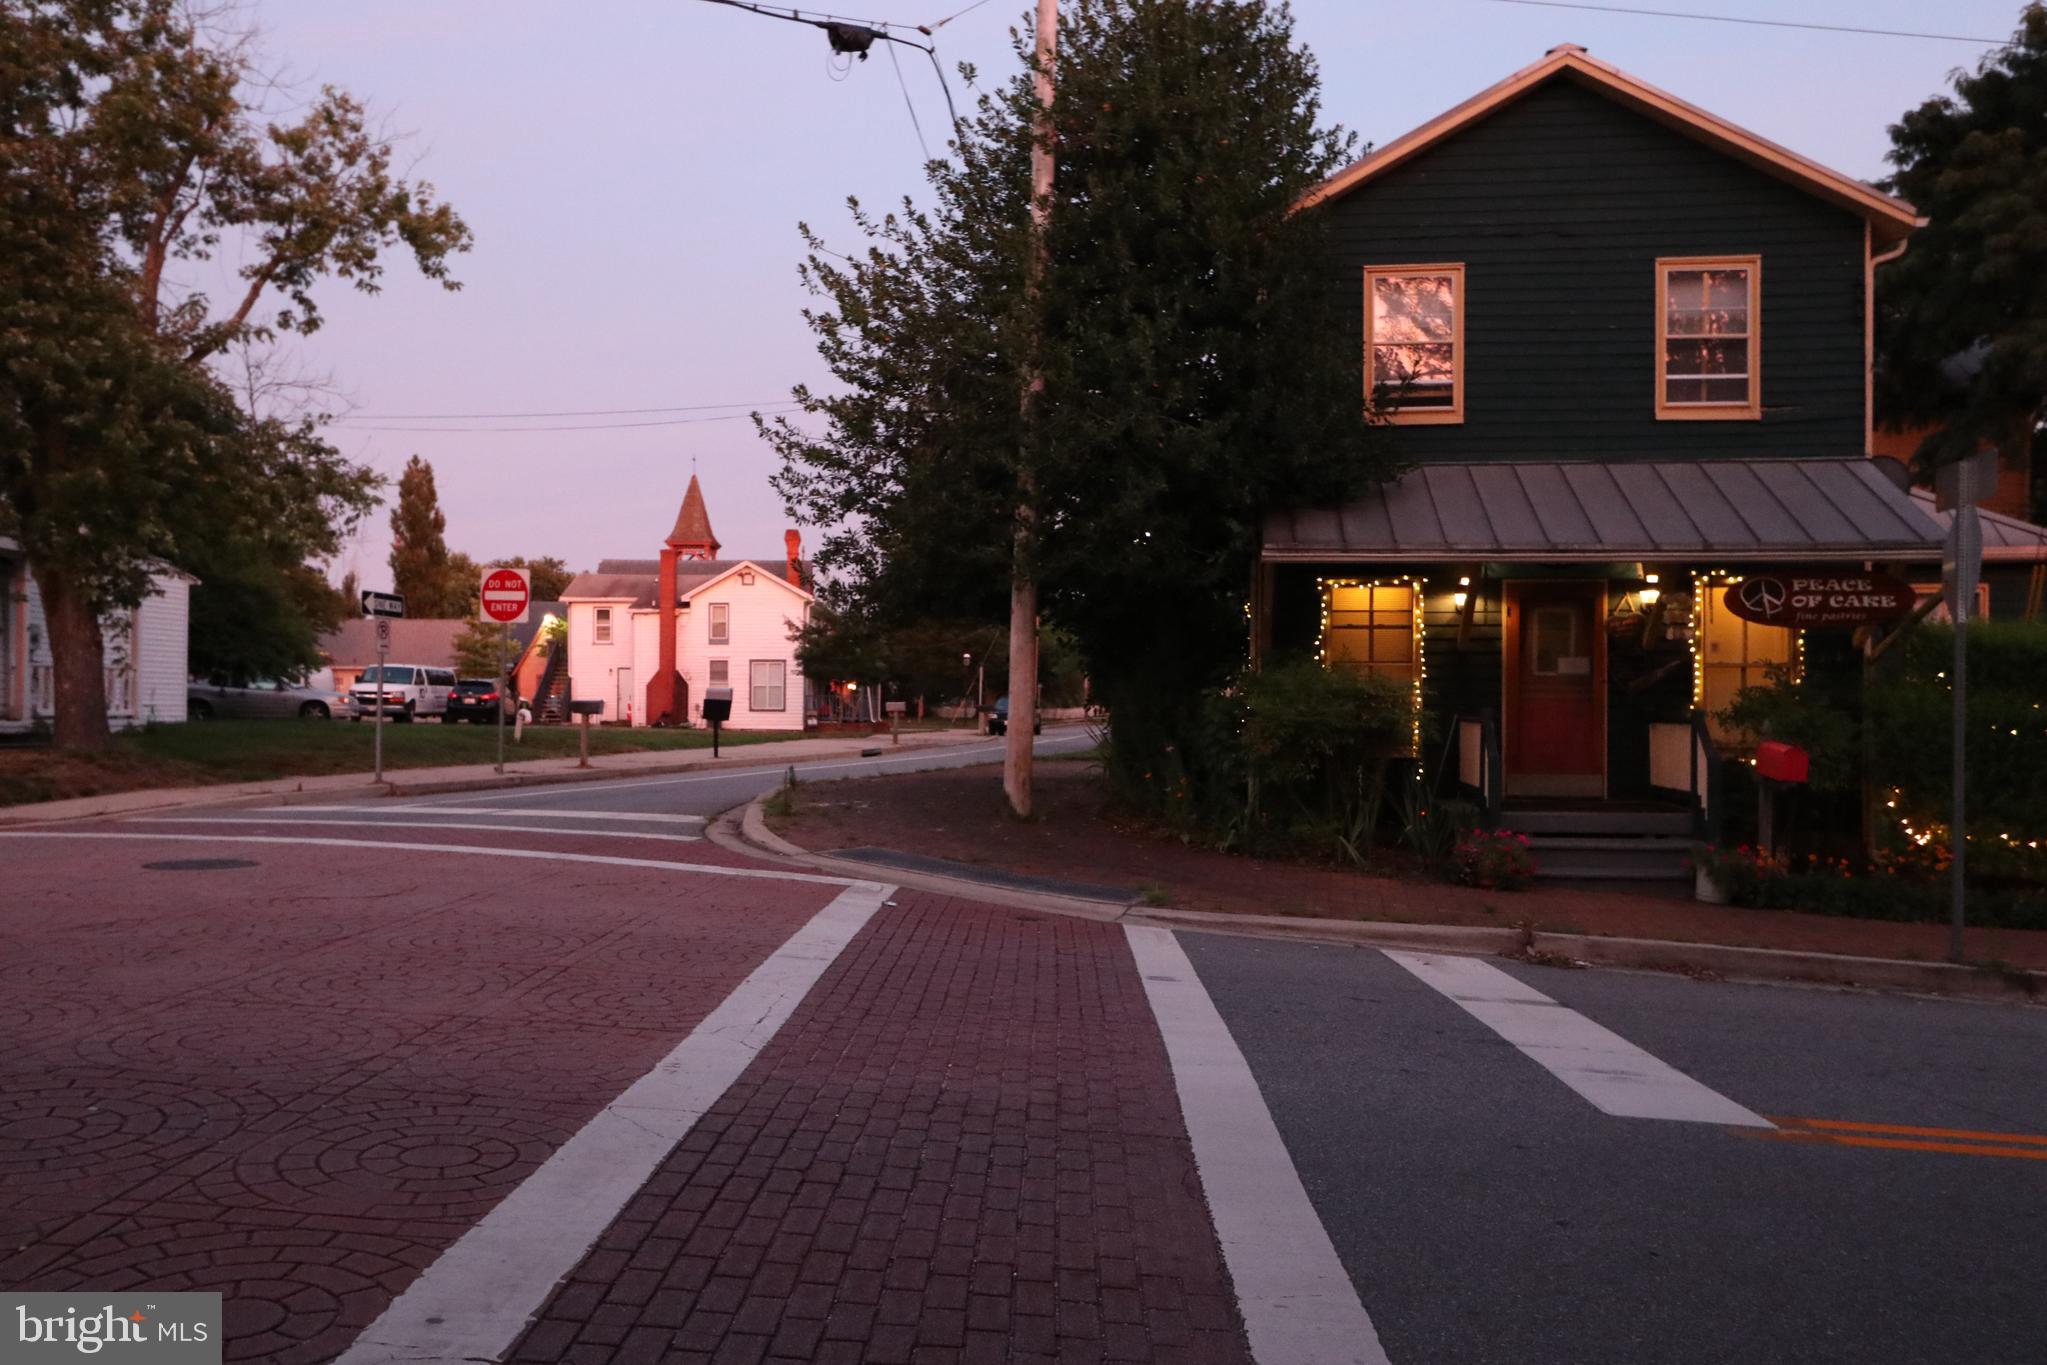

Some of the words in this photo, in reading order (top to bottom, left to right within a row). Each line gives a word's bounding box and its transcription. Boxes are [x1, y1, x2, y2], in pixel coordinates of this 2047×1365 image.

[488, 579, 500, 589] DO
[504, 579, 521, 589] NOT
[1792, 578, 1873, 592] PEACE
[389, 601, 402, 610] WAY
[1791, 595, 1822, 608] OF
[1829, 595, 1897, 608] CAKE
[491, 603, 518, 612] ENTER
